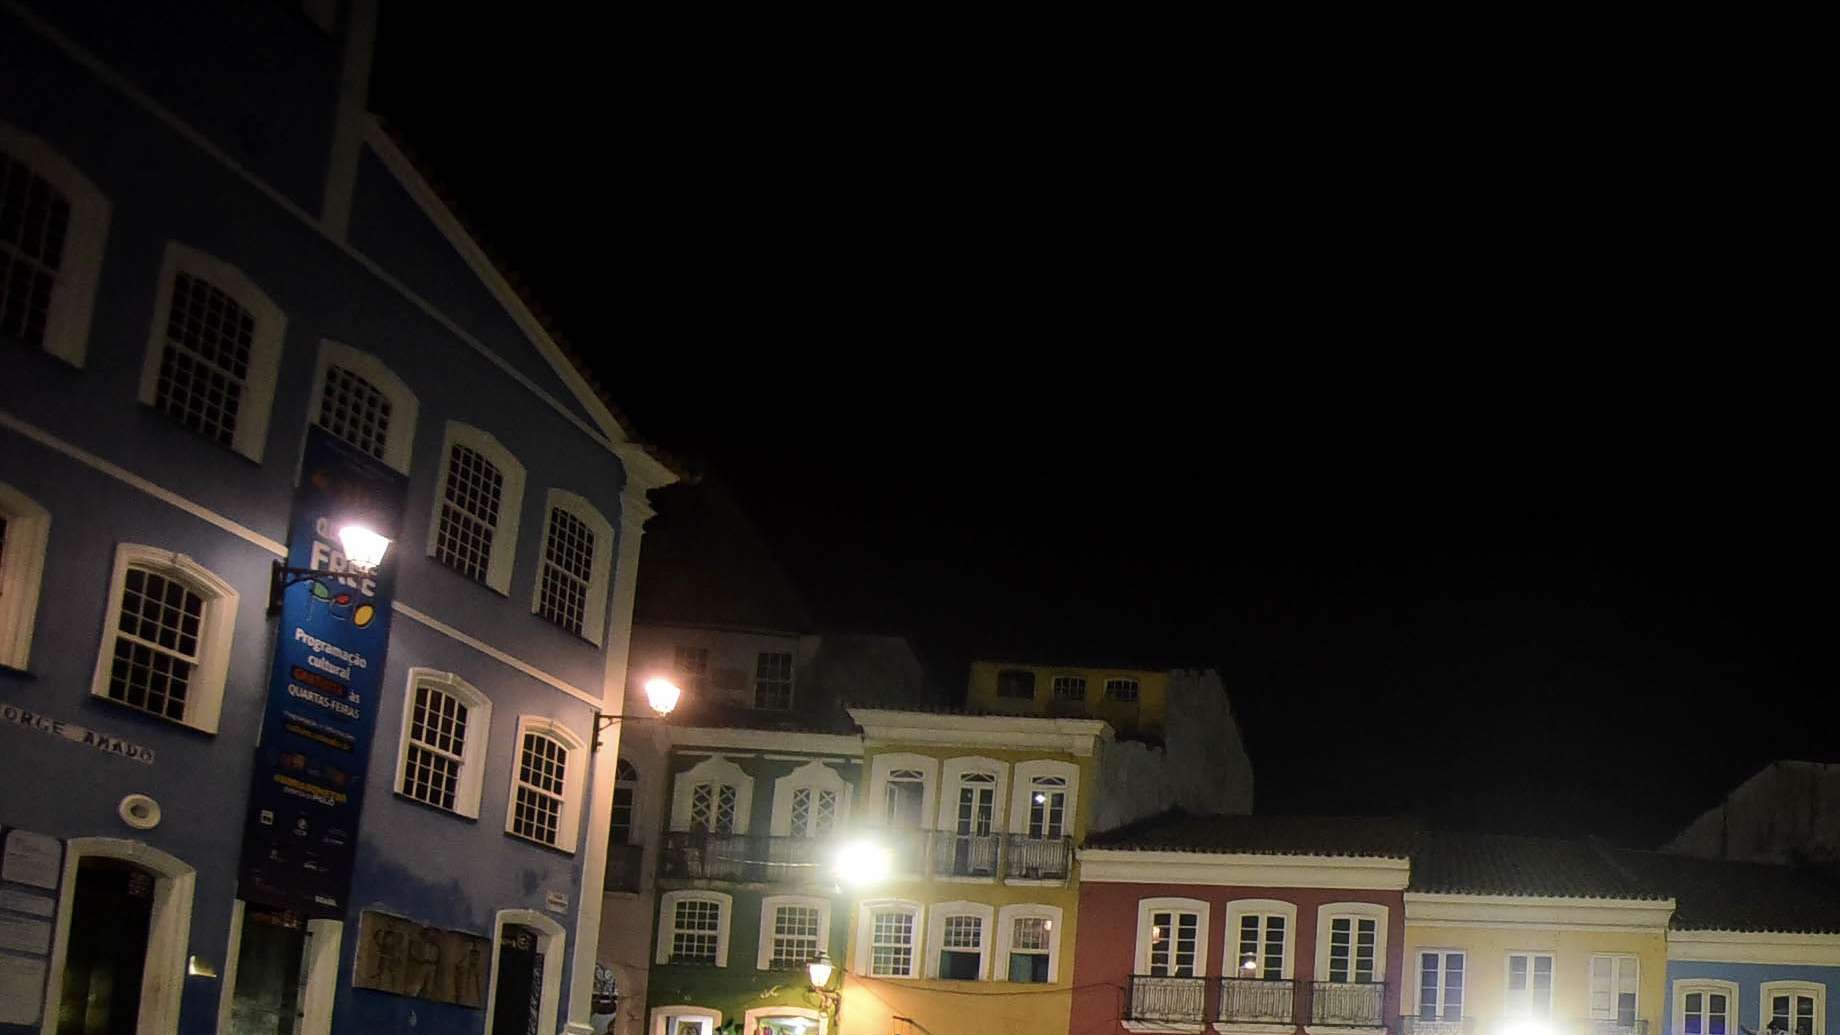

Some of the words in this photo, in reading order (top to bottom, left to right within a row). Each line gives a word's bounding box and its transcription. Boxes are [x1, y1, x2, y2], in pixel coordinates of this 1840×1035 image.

[294, 627, 367, 669] Programação
[308, 655, 351, 681] cultural
[4, 706, 63, 736] ORGE
[84, 731, 153, 761] AMADO
